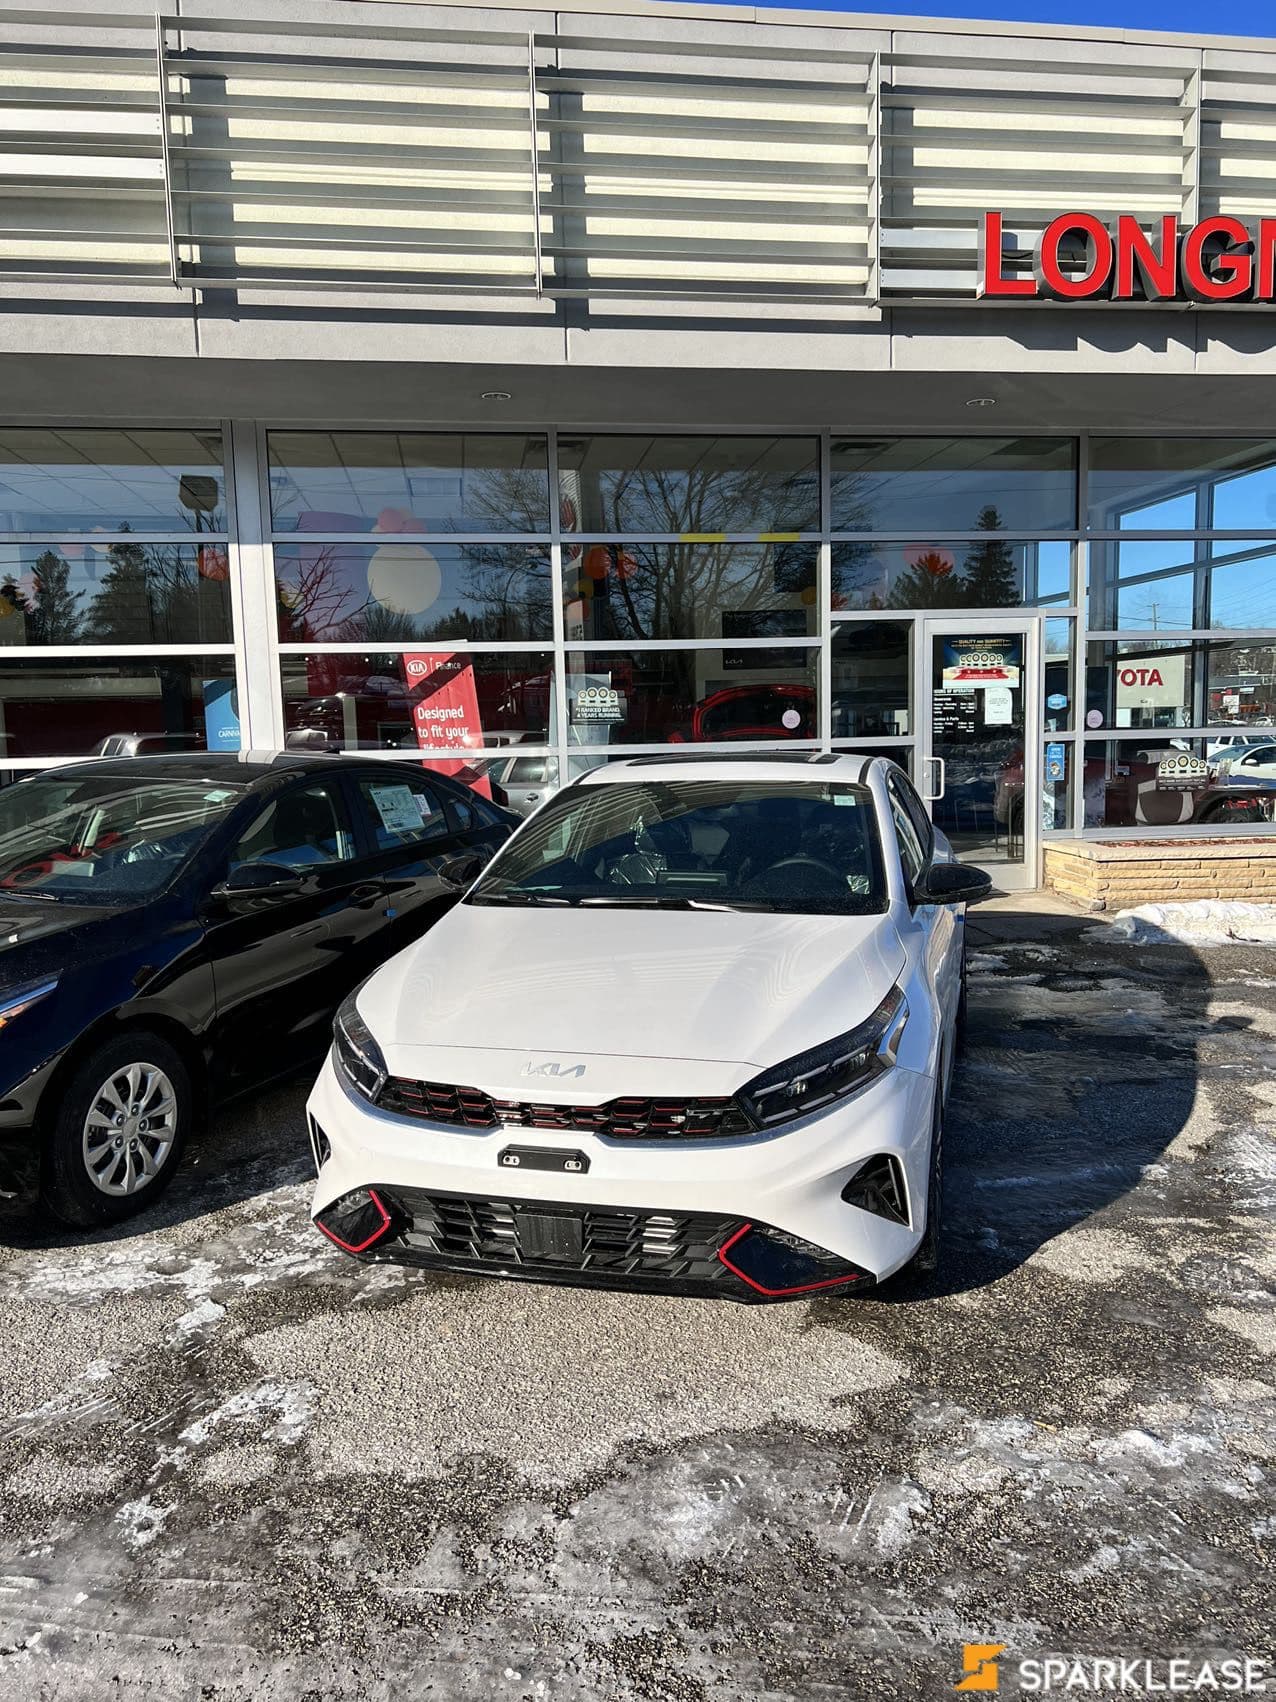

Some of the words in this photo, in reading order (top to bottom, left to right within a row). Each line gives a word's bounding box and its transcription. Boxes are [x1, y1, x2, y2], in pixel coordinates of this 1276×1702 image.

[979, 212, 1276, 298] LONG
[417, 705, 464, 721] Designed
[418, 726, 428, 738] to
[431, 724, 444, 738] fit
[446, 726, 469, 740] your
[521, 1061, 586, 1078] KIA
